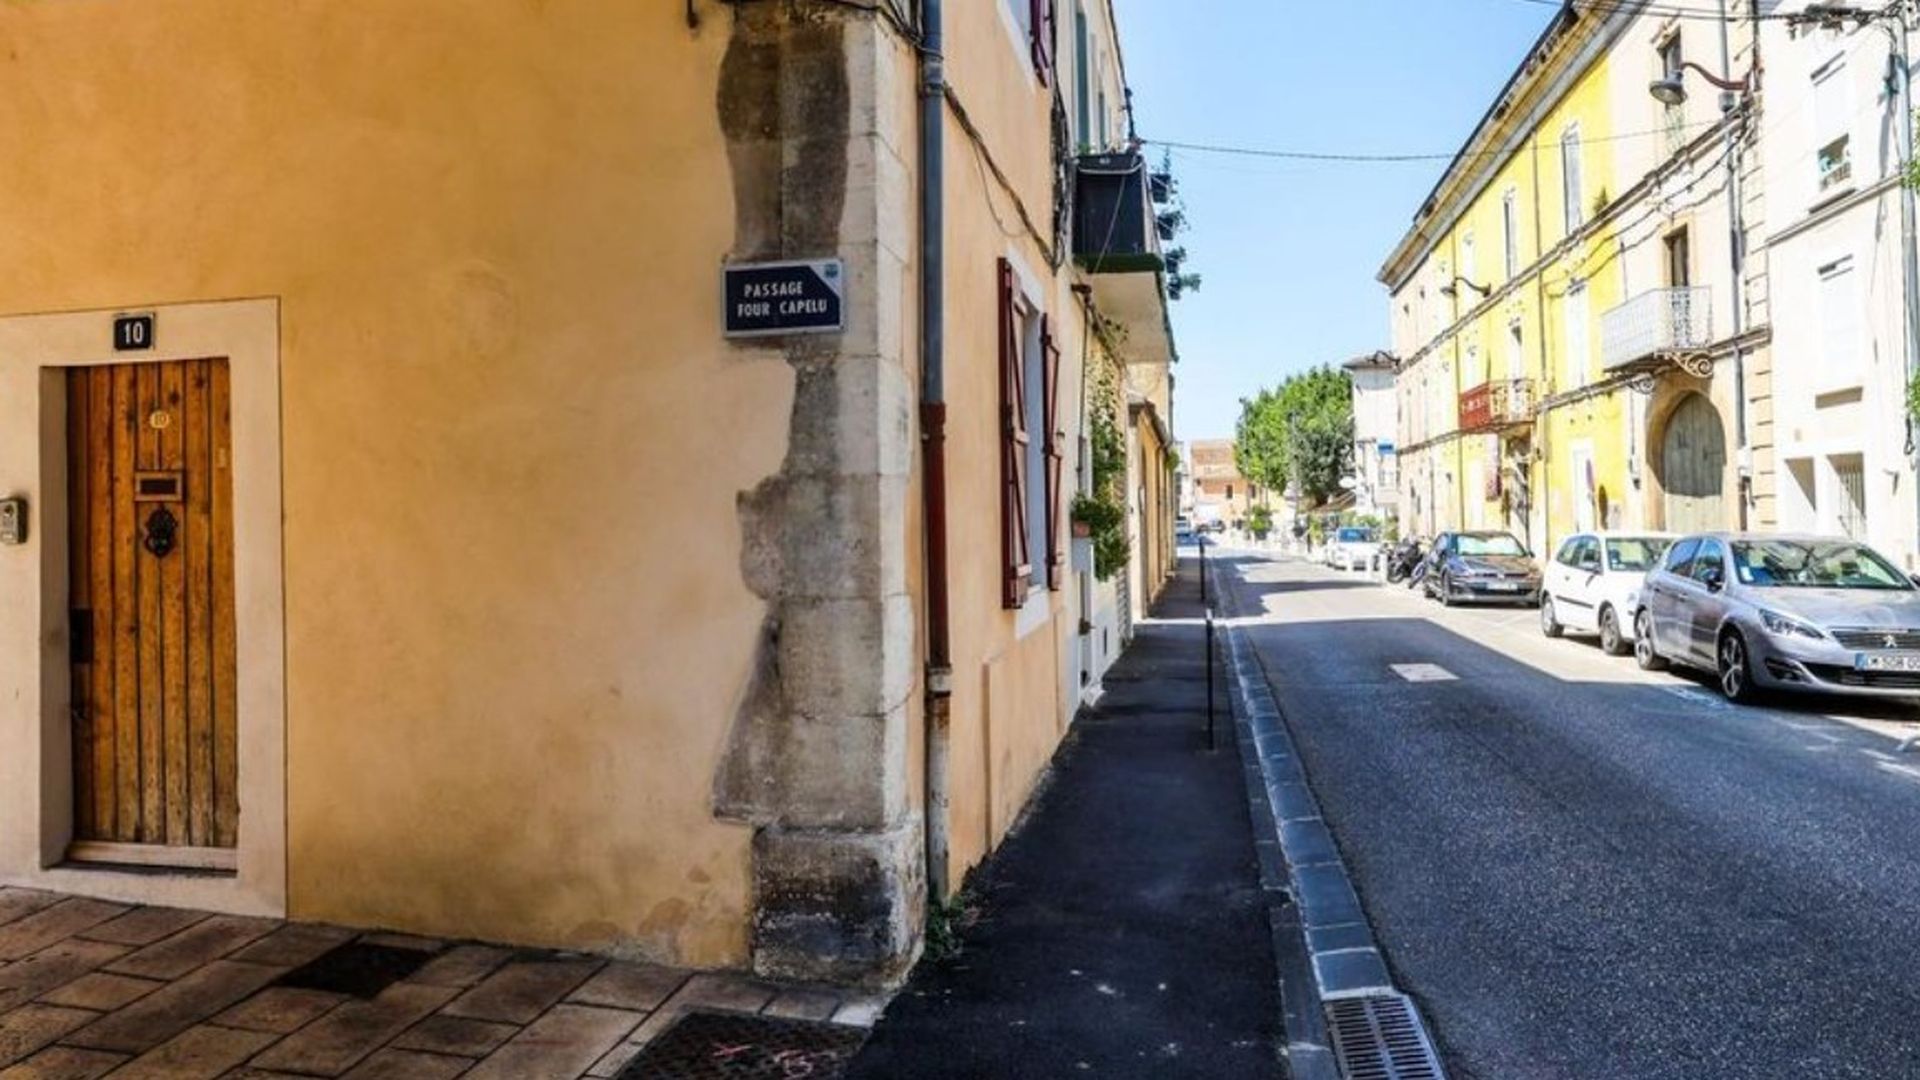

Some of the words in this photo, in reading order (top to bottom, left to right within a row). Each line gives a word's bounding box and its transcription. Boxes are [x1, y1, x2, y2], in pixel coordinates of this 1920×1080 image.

[743, 281, 803, 298] PASSAGE
[737, 302, 770, 318] FOUR
[779, 299, 828, 314] CAPELU
[125, 321, 144, 344] 10
